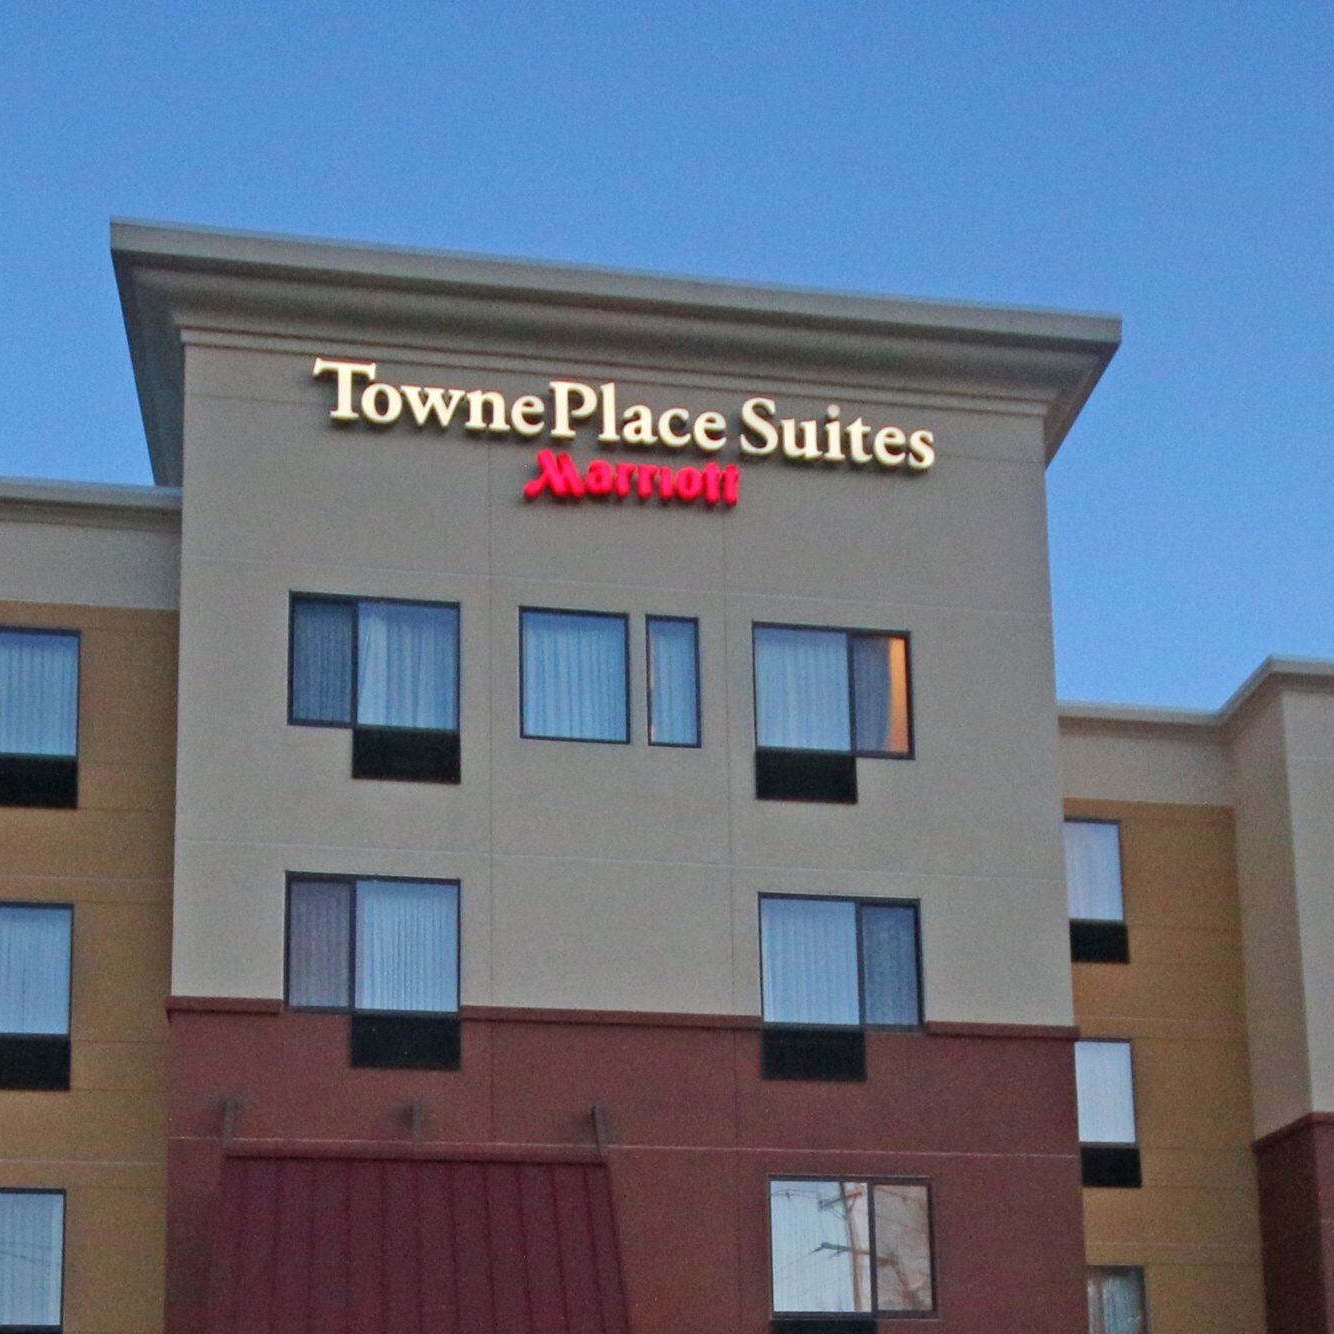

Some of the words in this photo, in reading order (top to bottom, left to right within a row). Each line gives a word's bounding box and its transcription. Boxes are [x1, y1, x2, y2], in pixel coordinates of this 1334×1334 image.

[313, 357, 727, 451] TownePlace
[740, 397, 936, 470] Suites
[524, 449, 740, 506] Marriott
